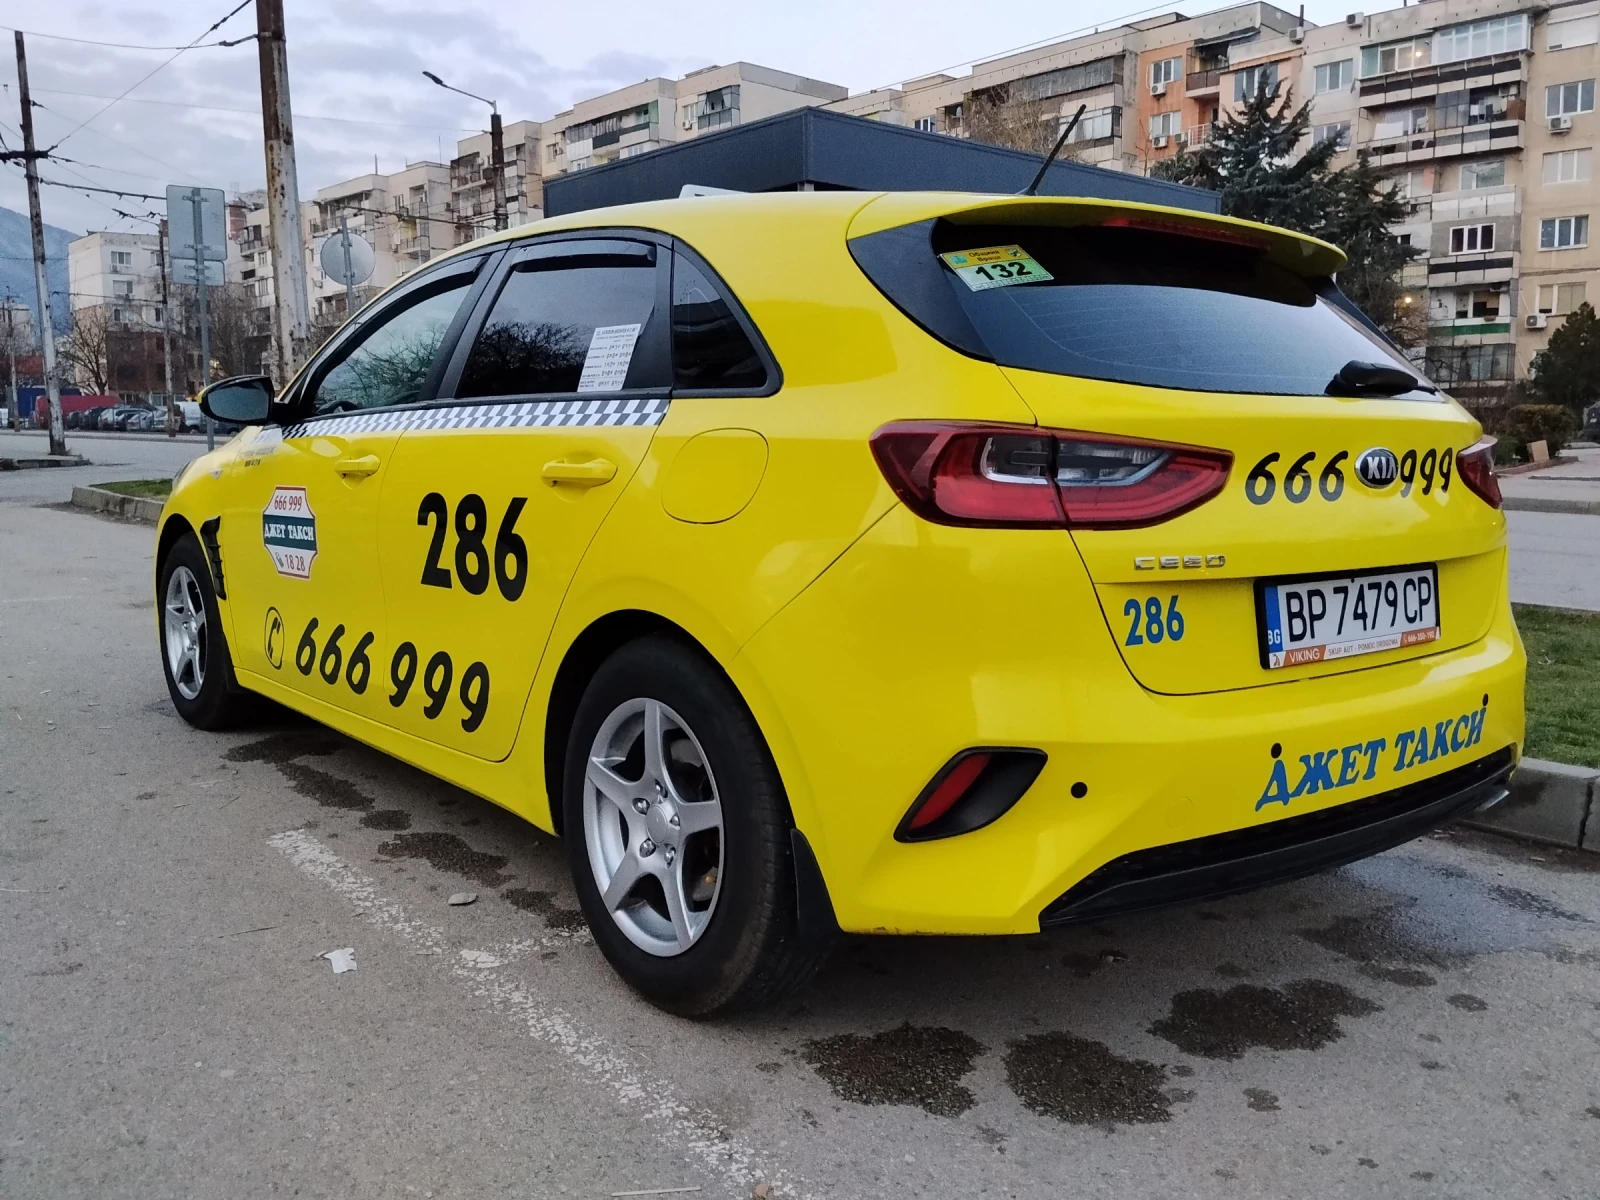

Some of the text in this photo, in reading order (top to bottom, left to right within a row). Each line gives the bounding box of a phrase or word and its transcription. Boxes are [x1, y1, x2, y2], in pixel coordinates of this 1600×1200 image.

[975, 261, 1033, 281] 132
[1244, 447, 1453, 505] 666 999
[1366, 456, 1397, 479] KIA
[274, 495, 302, 511] 666 999
[264, 523, 314, 541] ДЖЕТ ТАКСИ
[417, 492, 529, 602] 286
[1134, 554, 1226, 570] CEED
[1123, 595, 1185, 646] 286
[1267, 628, 1281, 645] BG
[1288, 650, 1320, 663] VIKING
[1328, 645, 1342, 656] SKUP
[1343, 642, 1354, 653] AUT
[1358, 641, 1376, 651] POMOC
[295, 617, 490, 733] 666 999
[1254, 706, 1487, 812] ДЖЕТ ТАКСИ
